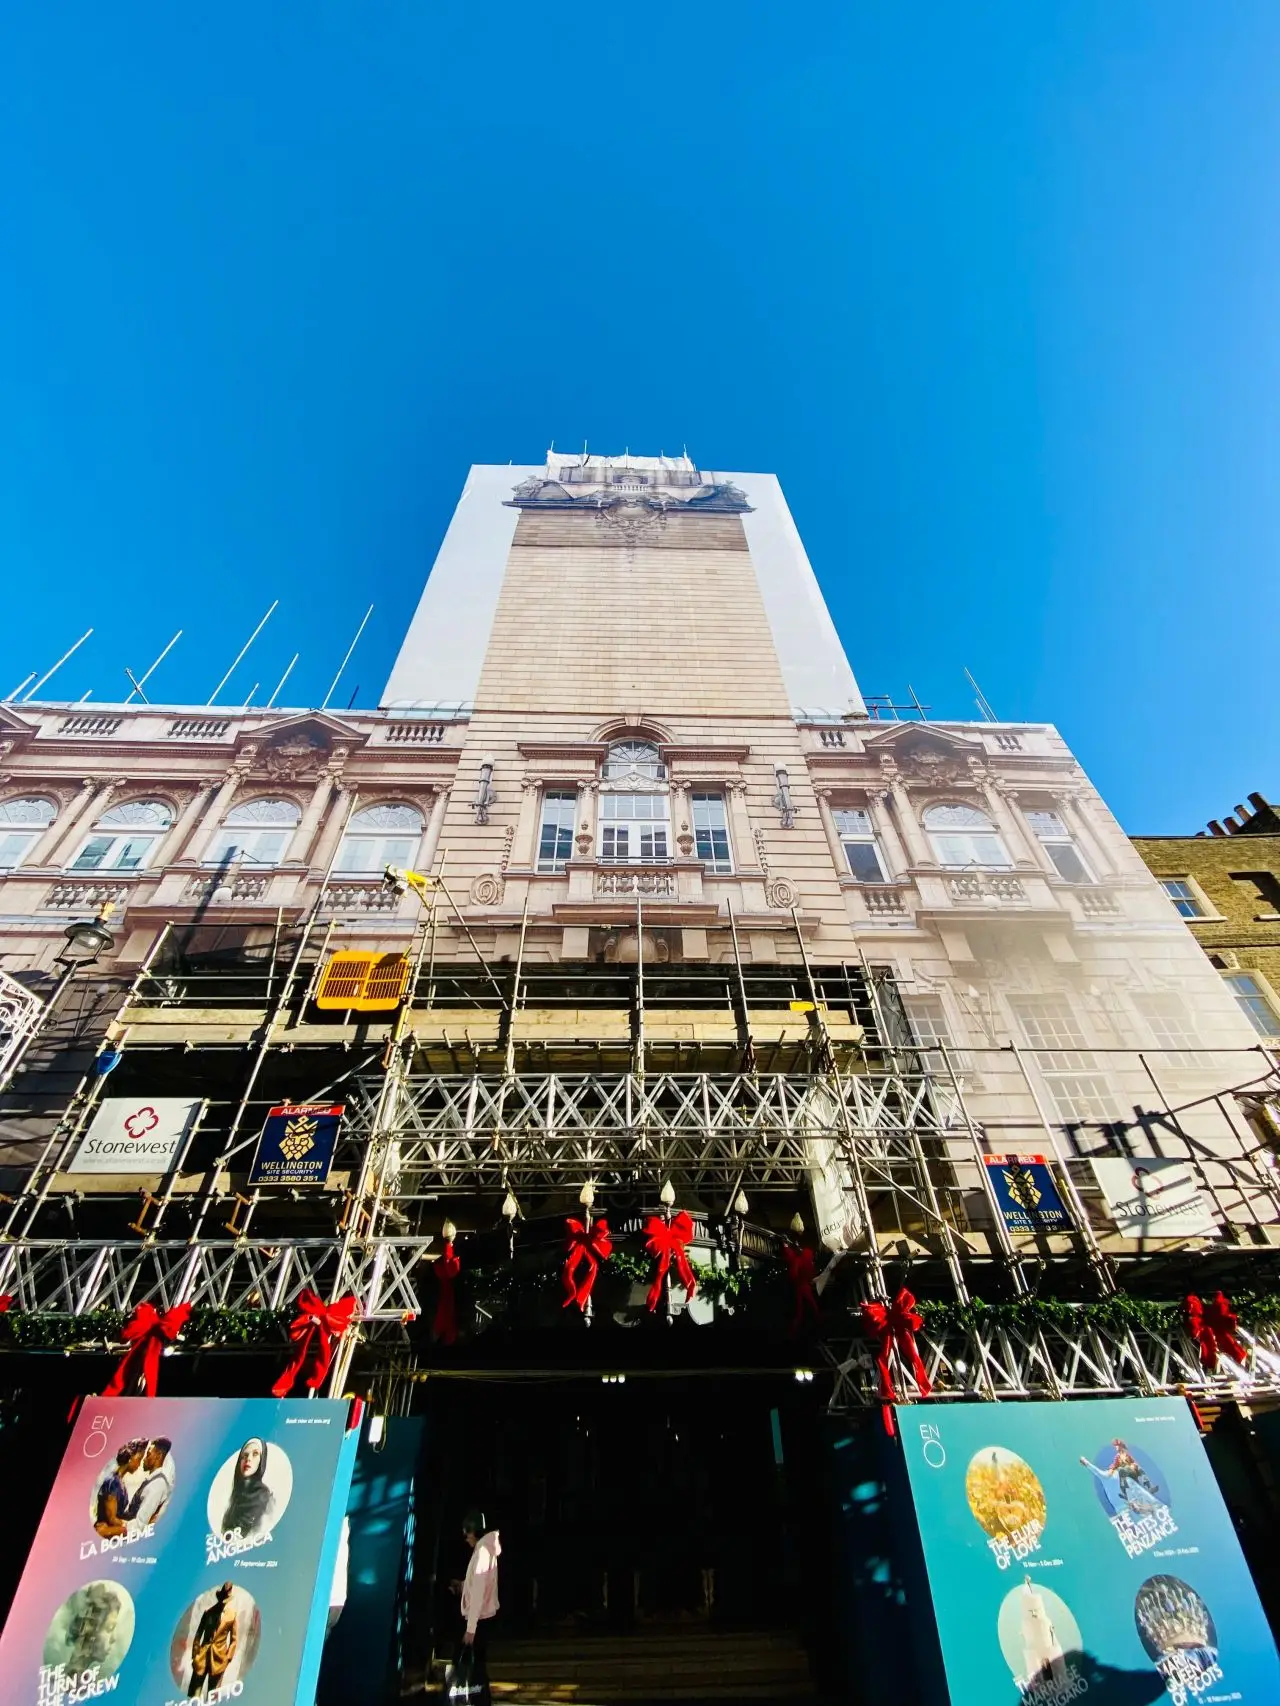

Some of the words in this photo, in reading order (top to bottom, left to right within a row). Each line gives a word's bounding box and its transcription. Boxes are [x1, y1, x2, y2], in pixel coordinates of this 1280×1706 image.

[84, 1138, 176, 1154] Stonewest
[989, 1155, 1036, 1164] ALARMED
[261, 1161, 323, 1170] WELLINGTON
[1003, 1210, 1063, 1220] WELLGTON
[1116, 1201, 1204, 1217] Stonewest
[1111, 1512, 1135, 1535] THE
[1118, 1514, 1157, 1546] PIRATES
[1156, 1504, 1172, 1522] OF
[80, 1543, 98, 1561] LA
[205, 1527, 243, 1552] SUOR
[206, 1530, 273, 1566] ANGELICA
[989, 1535, 1010, 1556] THE
[996, 1551, 1011, 1570] OF
[1009, 1535, 1042, 1561] LOVE
[1125, 1519, 1179, 1560] PENZANCE
[39, 1662, 66, 1685] THE
[1155, 1647, 1188, 1679] MARY
[1165, 1657, 1204, 1693] QUEEN
[38, 1672, 78, 1700] TURN
[80, 1665, 101, 1685] OF
[68, 1672, 120, 1705] SCREW
[1021, 1664, 1081, 1706] MARRIAGE
[1172, 1687, 1188, 1706] OF
[1187, 1662, 1224, 1697] SCOTS
